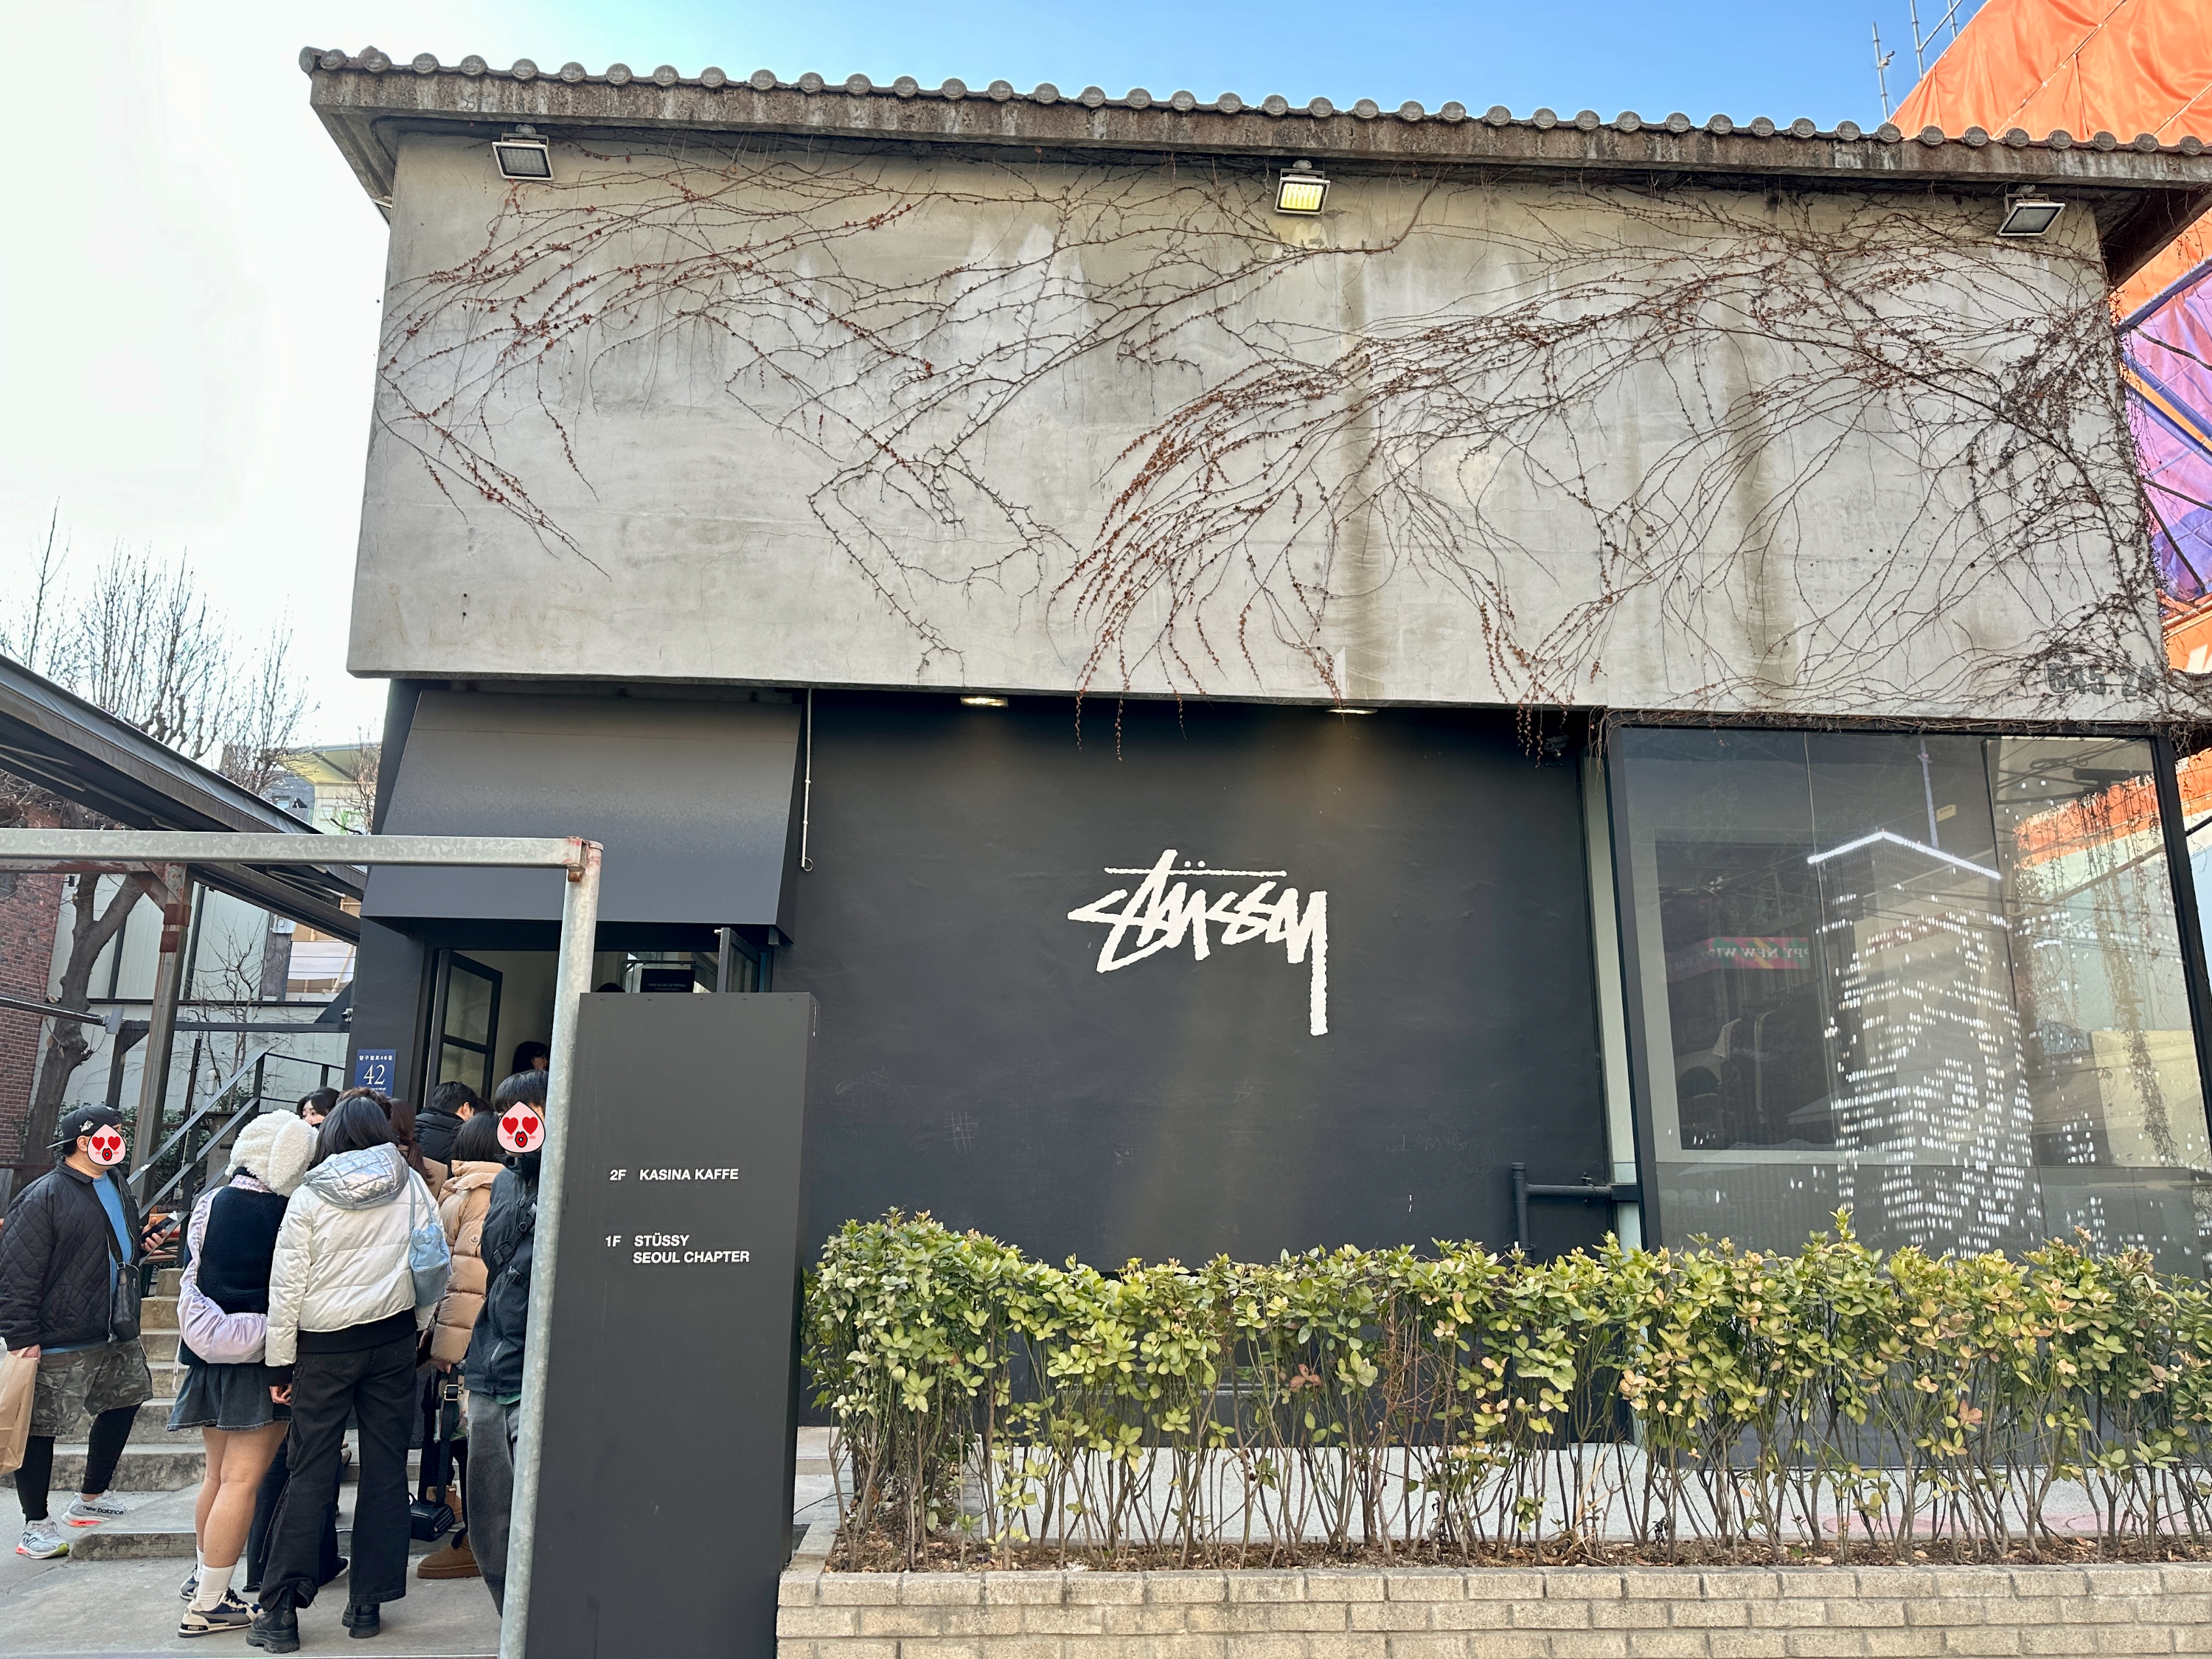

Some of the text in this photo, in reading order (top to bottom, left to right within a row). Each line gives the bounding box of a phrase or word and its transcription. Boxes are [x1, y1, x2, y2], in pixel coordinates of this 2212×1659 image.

[363, 1064, 386, 1085] 42
[609, 1168, 739, 1180] 2F KASINA KAFFE
[605, 1232, 689, 1247] 1F STÜSSY
[633, 1251, 750, 1263] SEOUL CHAPTER
[97, 1507, 124, 1515] balance
